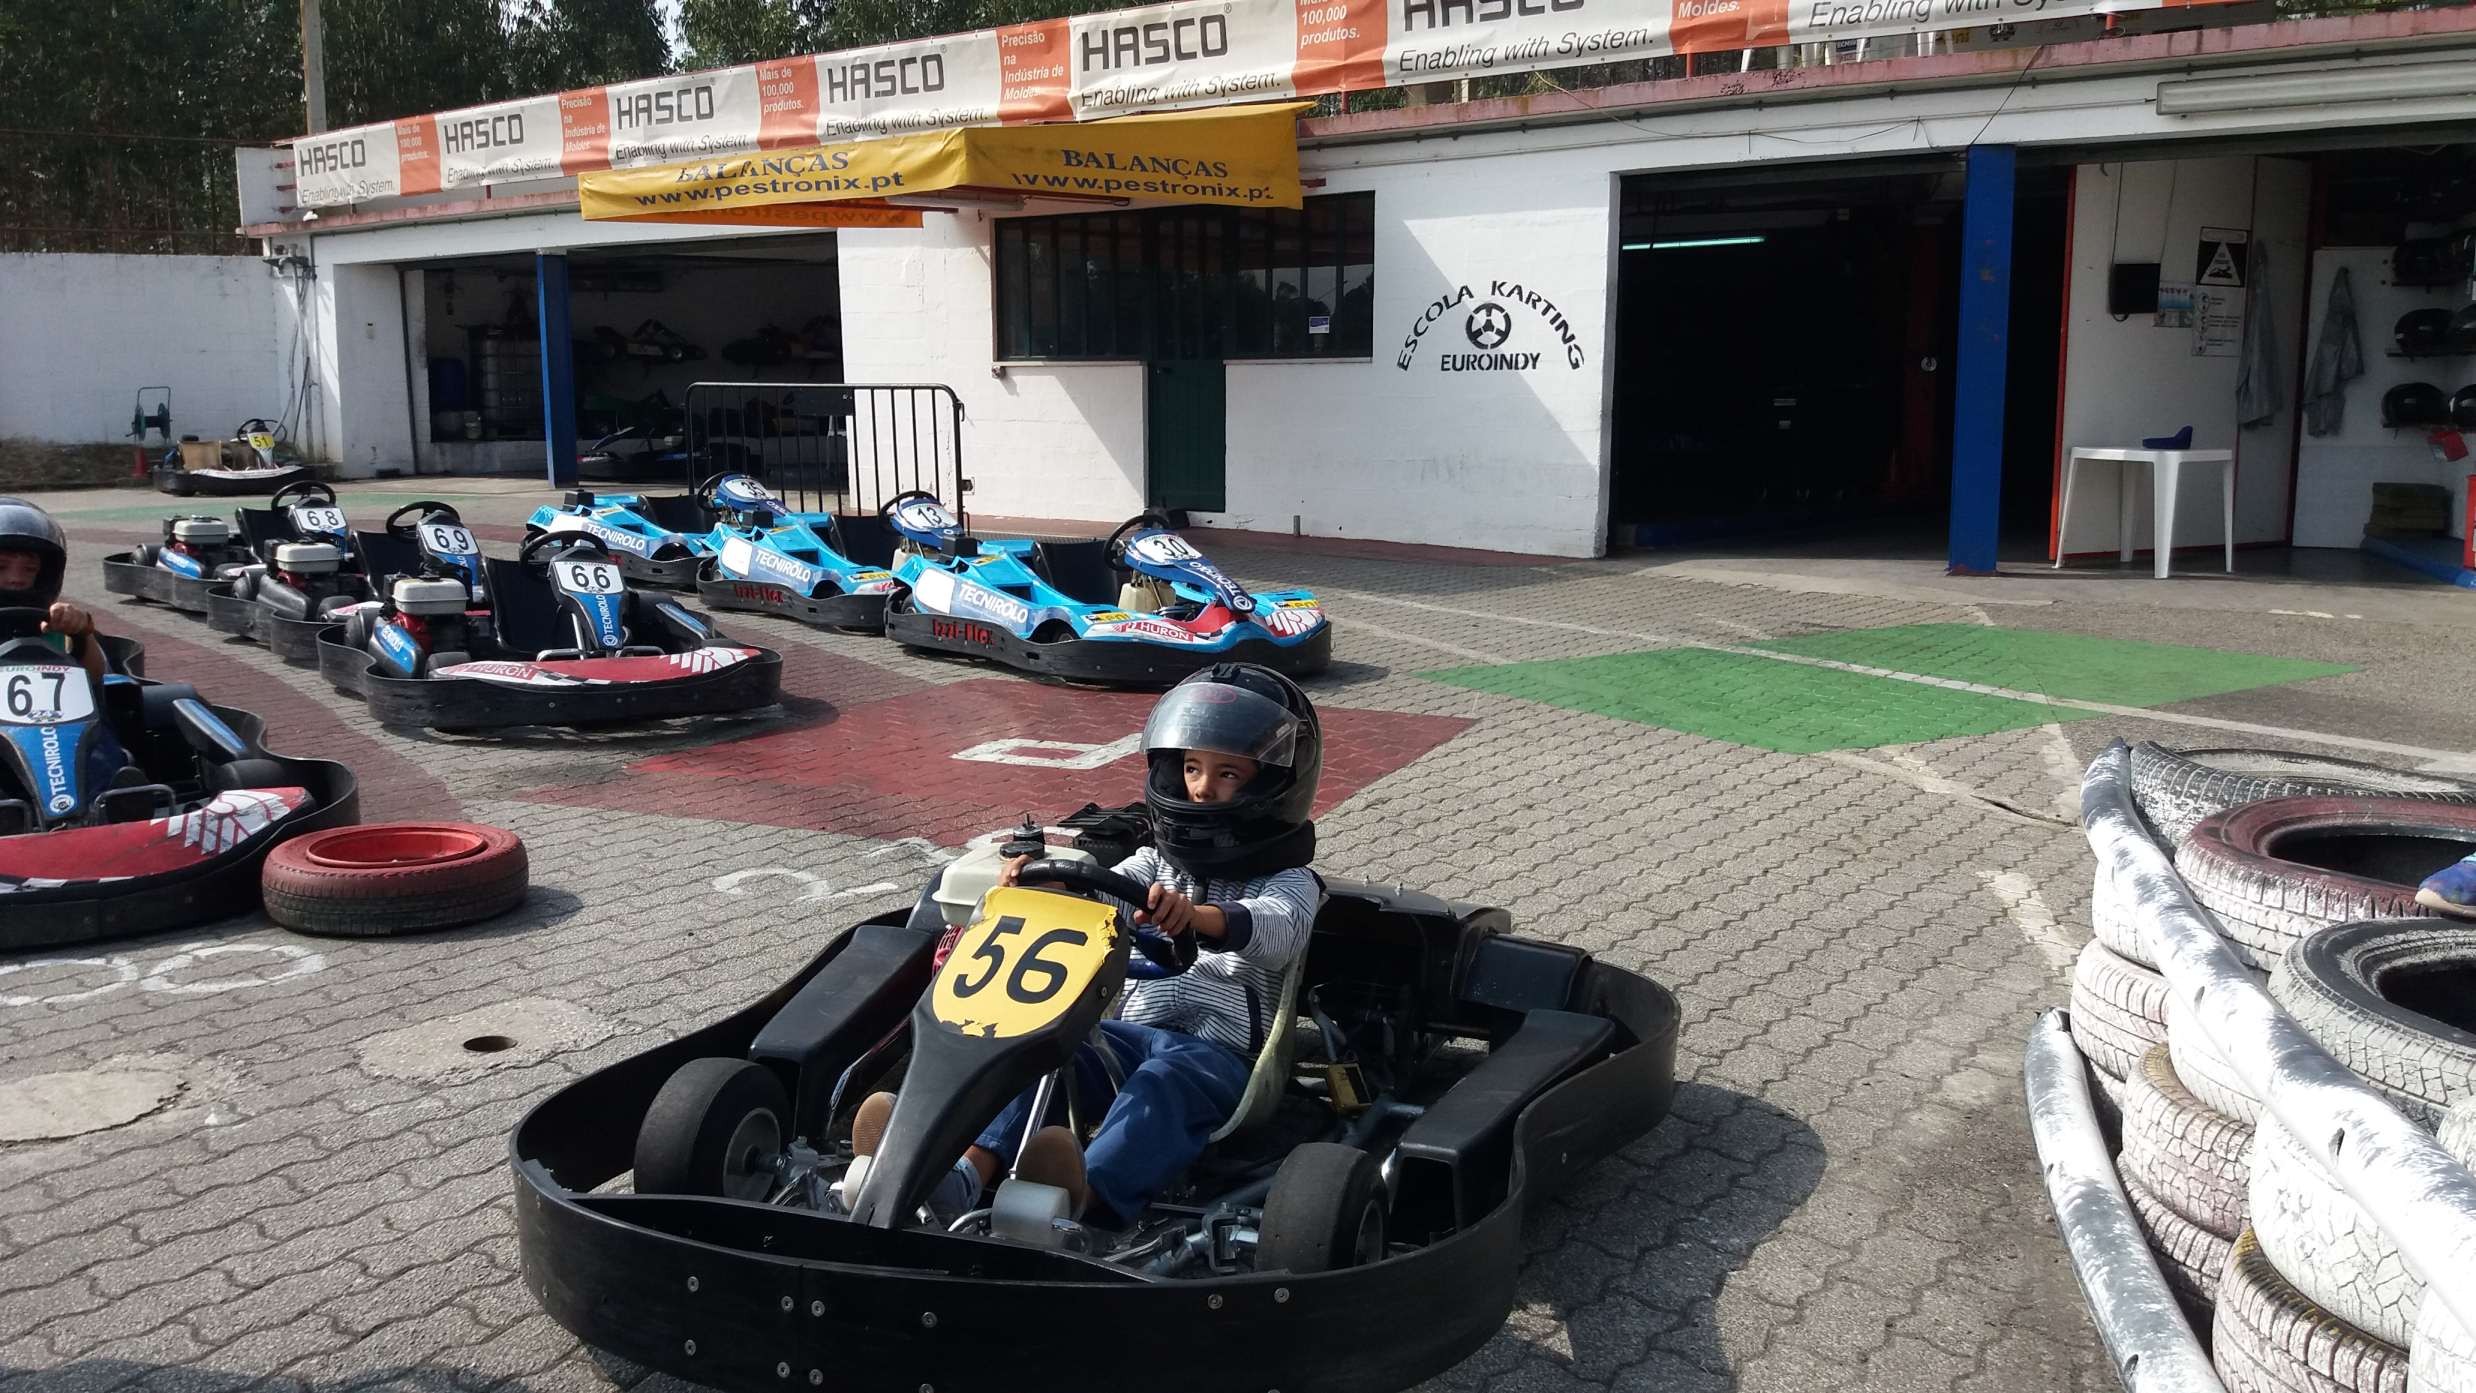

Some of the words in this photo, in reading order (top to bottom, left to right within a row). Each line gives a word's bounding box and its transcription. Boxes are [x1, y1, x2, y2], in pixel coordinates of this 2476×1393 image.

[1302, 4, 1347, 26] 100,000
[1678, 0, 1740, 18] Moldes.
[1808, 0, 1933, 28] Enabling
[1001, 32, 1045, 48] Precisão
[1082, 14, 1228, 72] HASCO
[1301, 27, 1361, 48] produtos.
[1400, 43, 1497, 72] Enabling
[1503, 35, 1550, 61] with
[1557, 27, 1654, 57] System.
[759, 69, 780, 82] Mais
[782, 66, 793, 78] de
[1004, 55, 1017, 65] na
[1004, 66, 1050, 83] Indústria
[1051, 63, 1064, 77] de
[761, 83, 794, 97] 100,000
[827, 53, 944, 104] HASCO
[1082, 84, 1160, 108] Enabling
[1163, 78, 1200, 100] with
[1204, 71, 1281, 100] System.
[616, 85, 714, 130] HASCO
[890, 112, 922, 130] with
[444, 113, 524, 154] HASCO
[299, 139, 366, 177] HASCO
[1060, 148, 1229, 180] BALANÇAS
[634, 170, 905, 207] www.pestronix.pt
[1396, 285, 1475, 372] ESCOLA
[1490, 280, 1585, 370] KARTING
[1440, 352, 1541, 372] EUROINDY
[253, 435, 270, 448] 51
[307, 510, 340, 526] 68
[917, 506, 943, 527] 13
[433, 527, 470, 551] 69
[586, 523, 646, 551] TECNIROLO
[1153, 538, 1189, 559] 30
[571, 564, 611, 589] 66
[754, 549, 812, 584] TECNIROLO
[595, 594, 614, 635] TECNIROLO
[958, 584, 1029, 625] TECNIROLO
[1140, 621, 1191, 641] HURON
[7, 672, 66, 717] 67
[40, 726, 67, 796] TECNIROLO
[952, 915, 1089, 1004] 56
